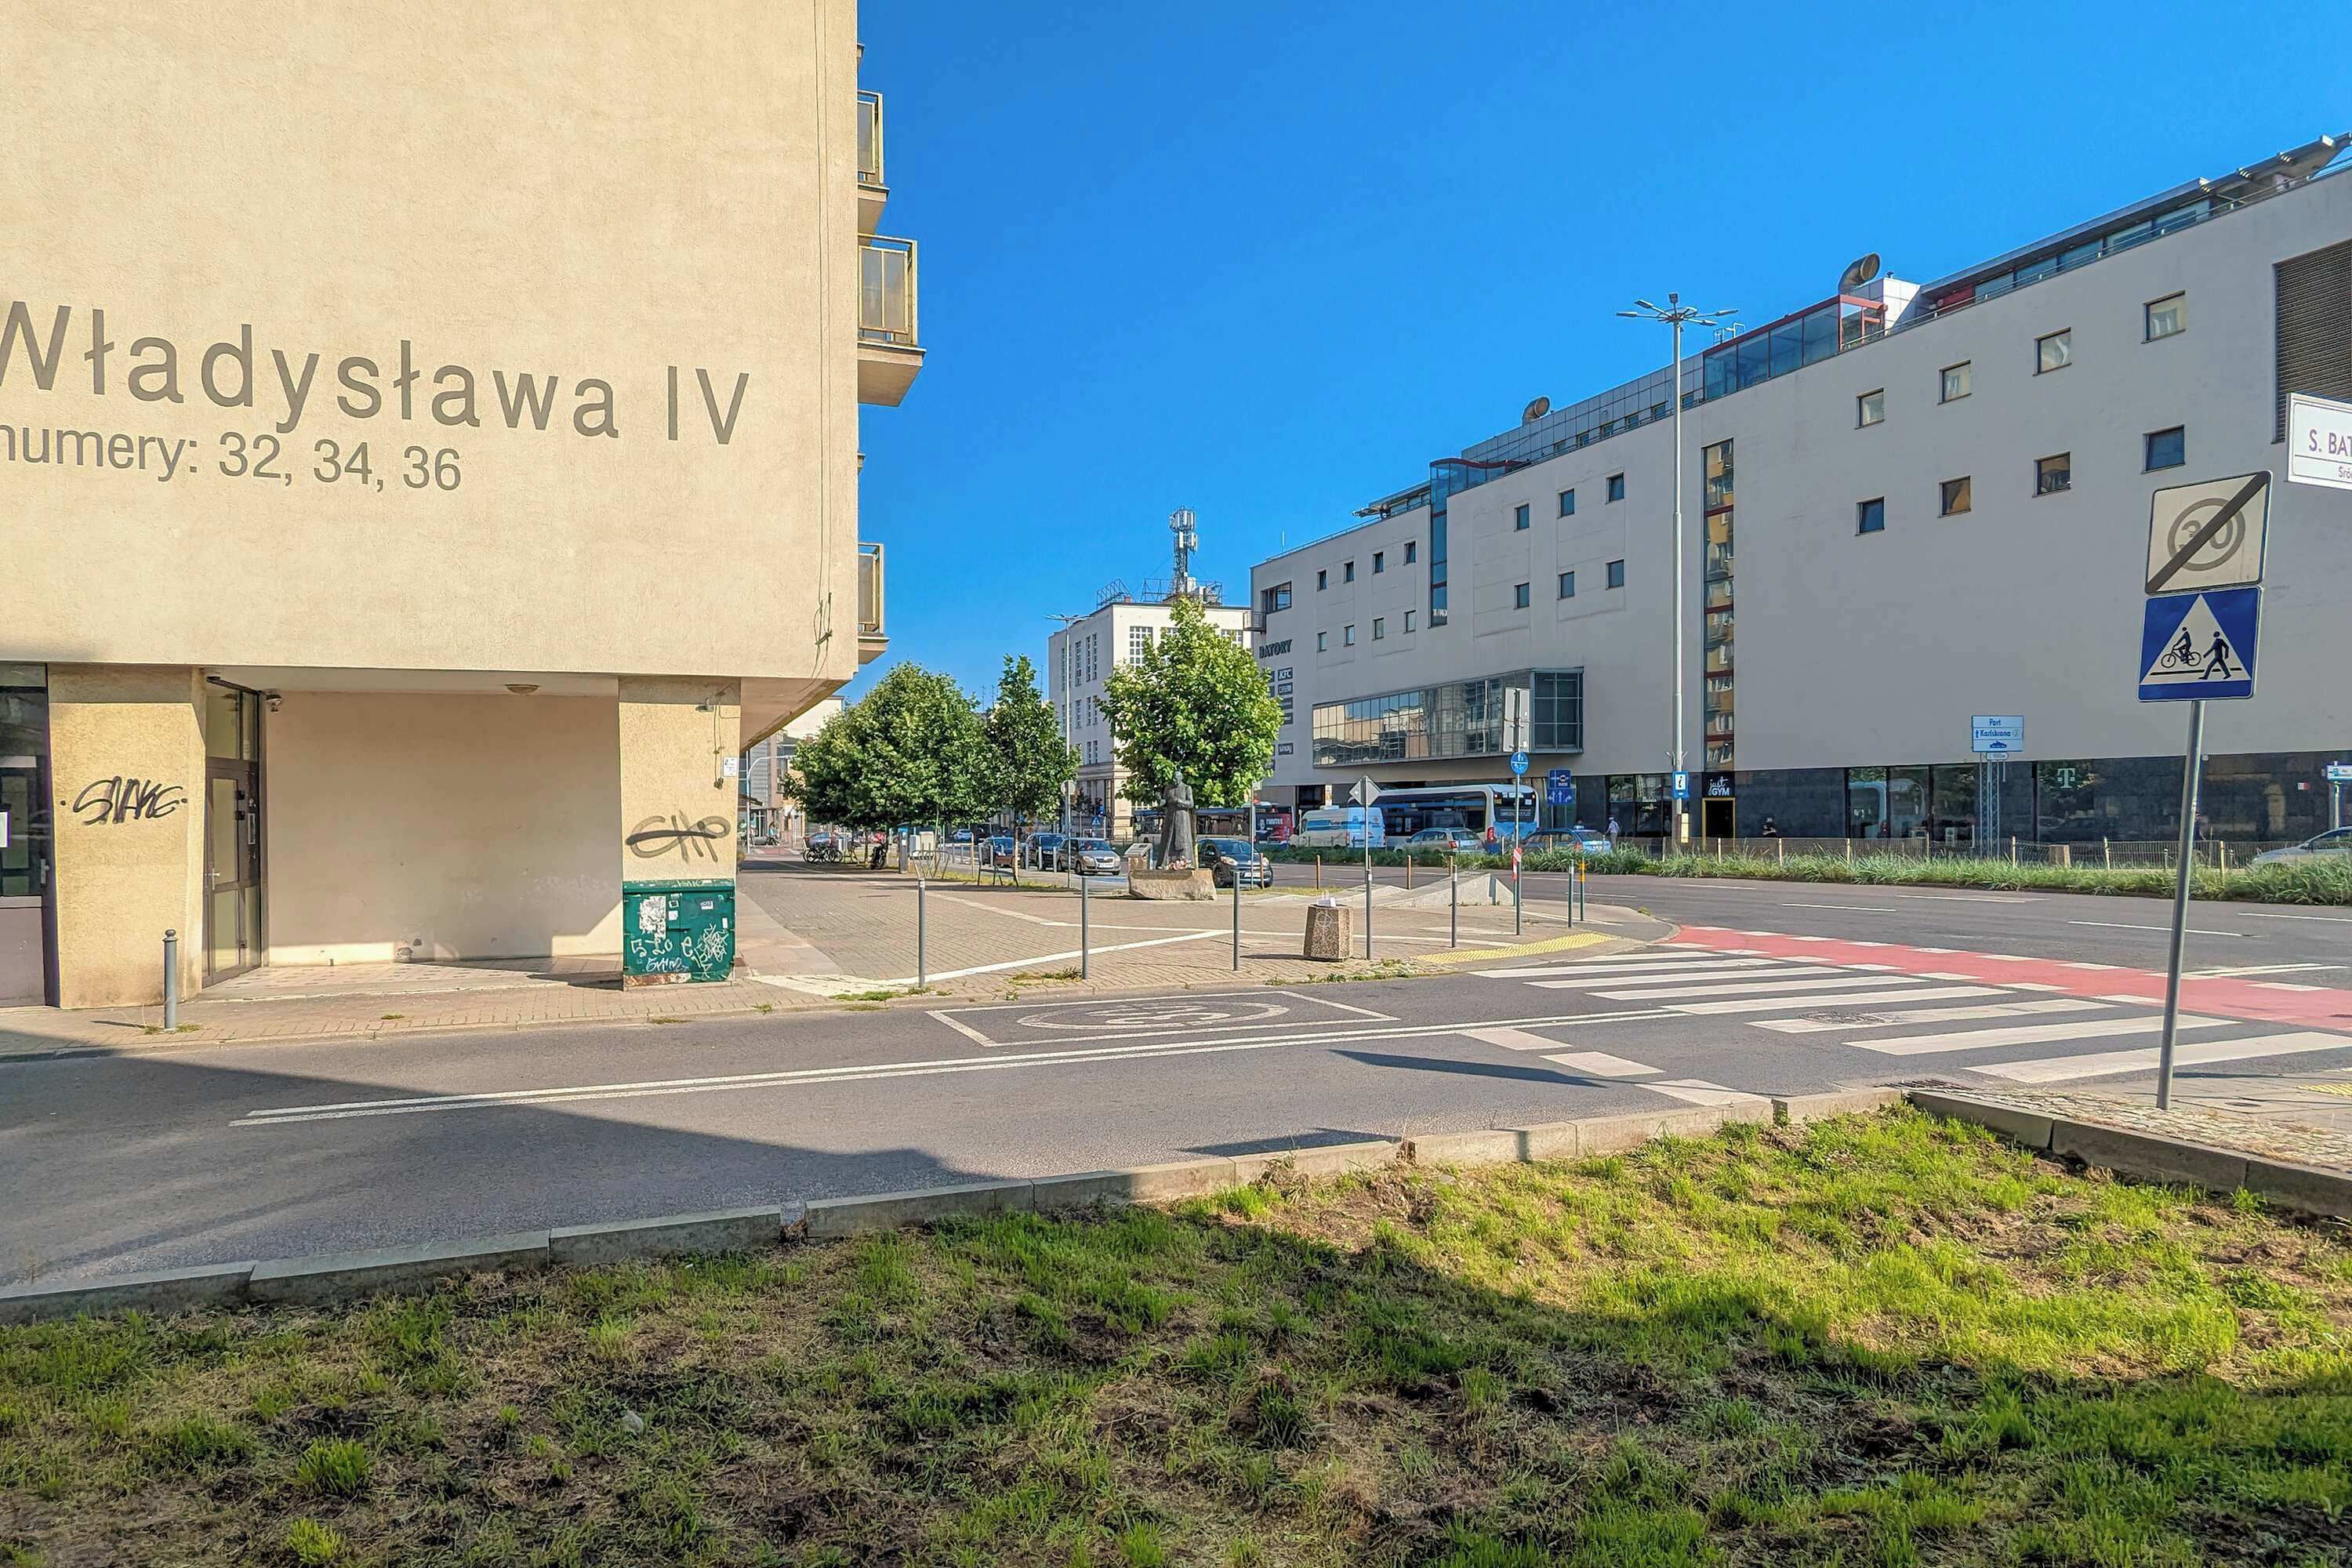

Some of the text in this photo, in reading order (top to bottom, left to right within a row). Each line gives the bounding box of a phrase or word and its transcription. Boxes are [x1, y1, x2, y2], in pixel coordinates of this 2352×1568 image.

[0, 299, 750, 445] Władysława IV
[2309, 428, 2322, 452] S.
[219, 431, 292, 487] 32,
[313, 439, 385, 493] 34,
[402, 446, 462, 492] 36
[1258, 638, 1293, 659] BATORY
[1279, 669, 1292, 681] KFC
[1711, 787, 1730, 797] GYM
